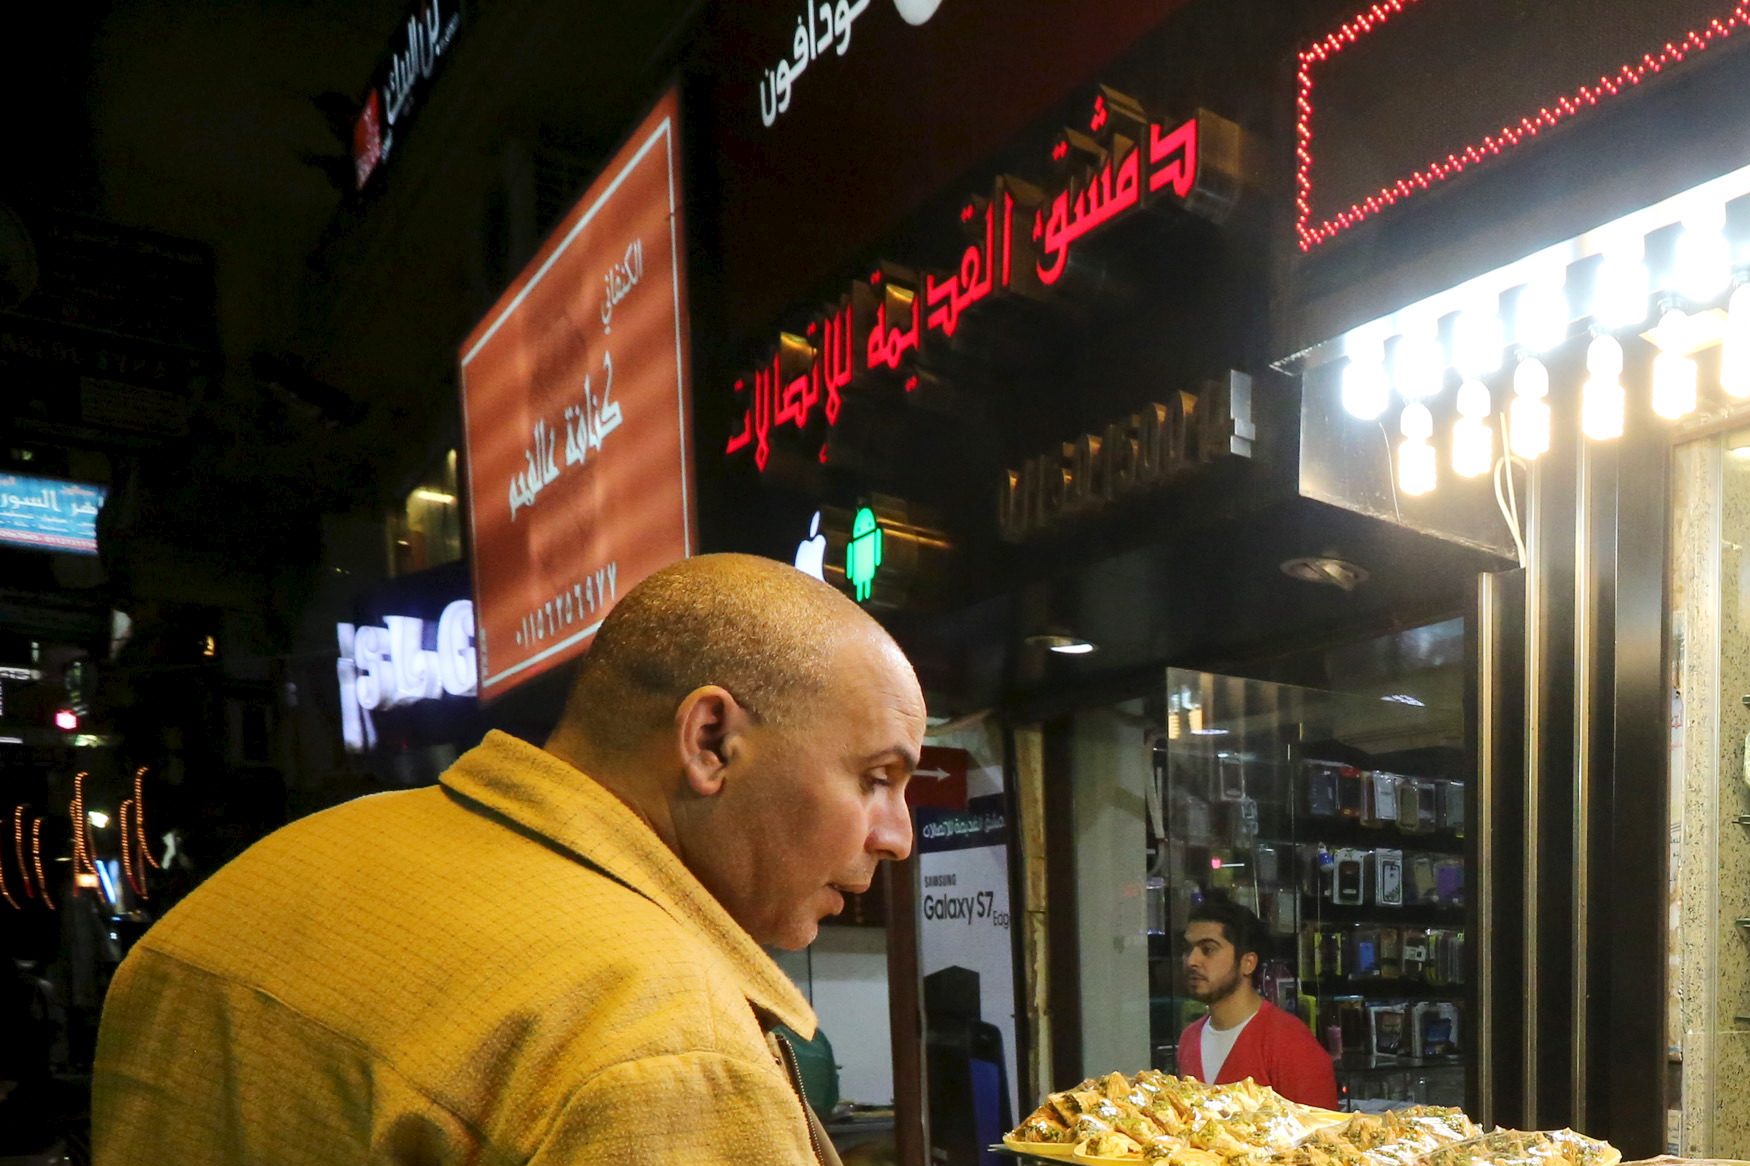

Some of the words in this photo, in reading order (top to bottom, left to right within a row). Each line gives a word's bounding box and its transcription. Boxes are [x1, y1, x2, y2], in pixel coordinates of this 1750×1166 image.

[1034, 95, 1198, 285] دمشق
[866, 191, 1014, 392] القديمة
[565, 350, 624, 467] كنافة
[923, 893, 975, 926] Galaxy
[976, 890, 994, 918] S7
[924, 873, 957, 888] SAMSUNG
[992, 910, 1010, 930] Edg
